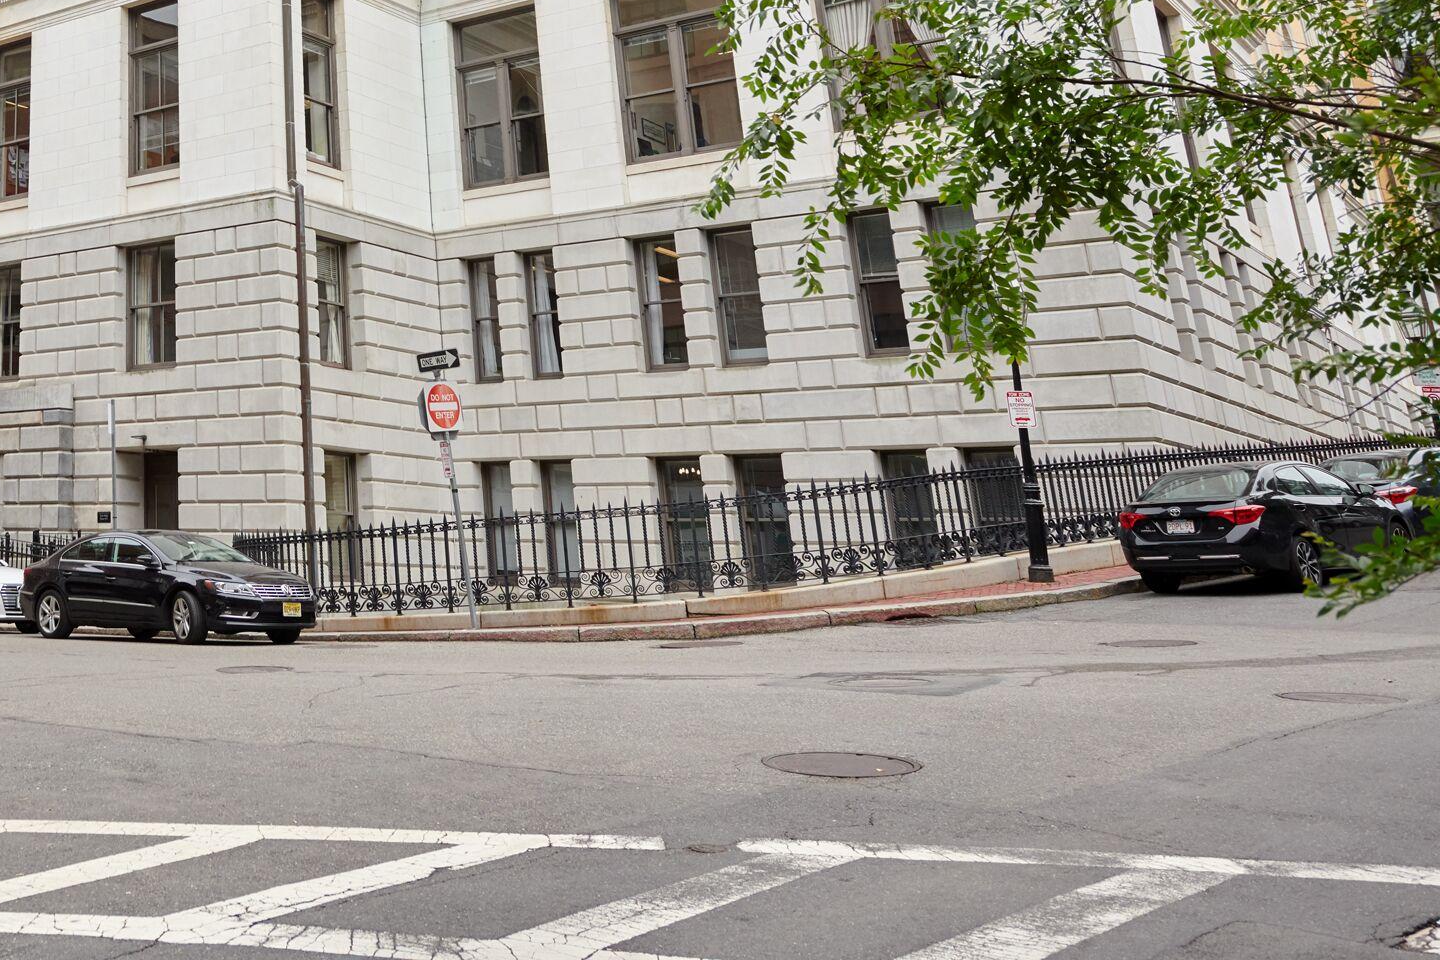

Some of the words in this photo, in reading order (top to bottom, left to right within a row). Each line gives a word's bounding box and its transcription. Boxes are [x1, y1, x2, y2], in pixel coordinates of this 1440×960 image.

[422, 358, 433, 367] ONE
[435, 355, 447, 365] WAY
[430, 393, 440, 402] DO
[441, 393, 455, 401] NOT
[435, 411, 455, 420] ENTER
